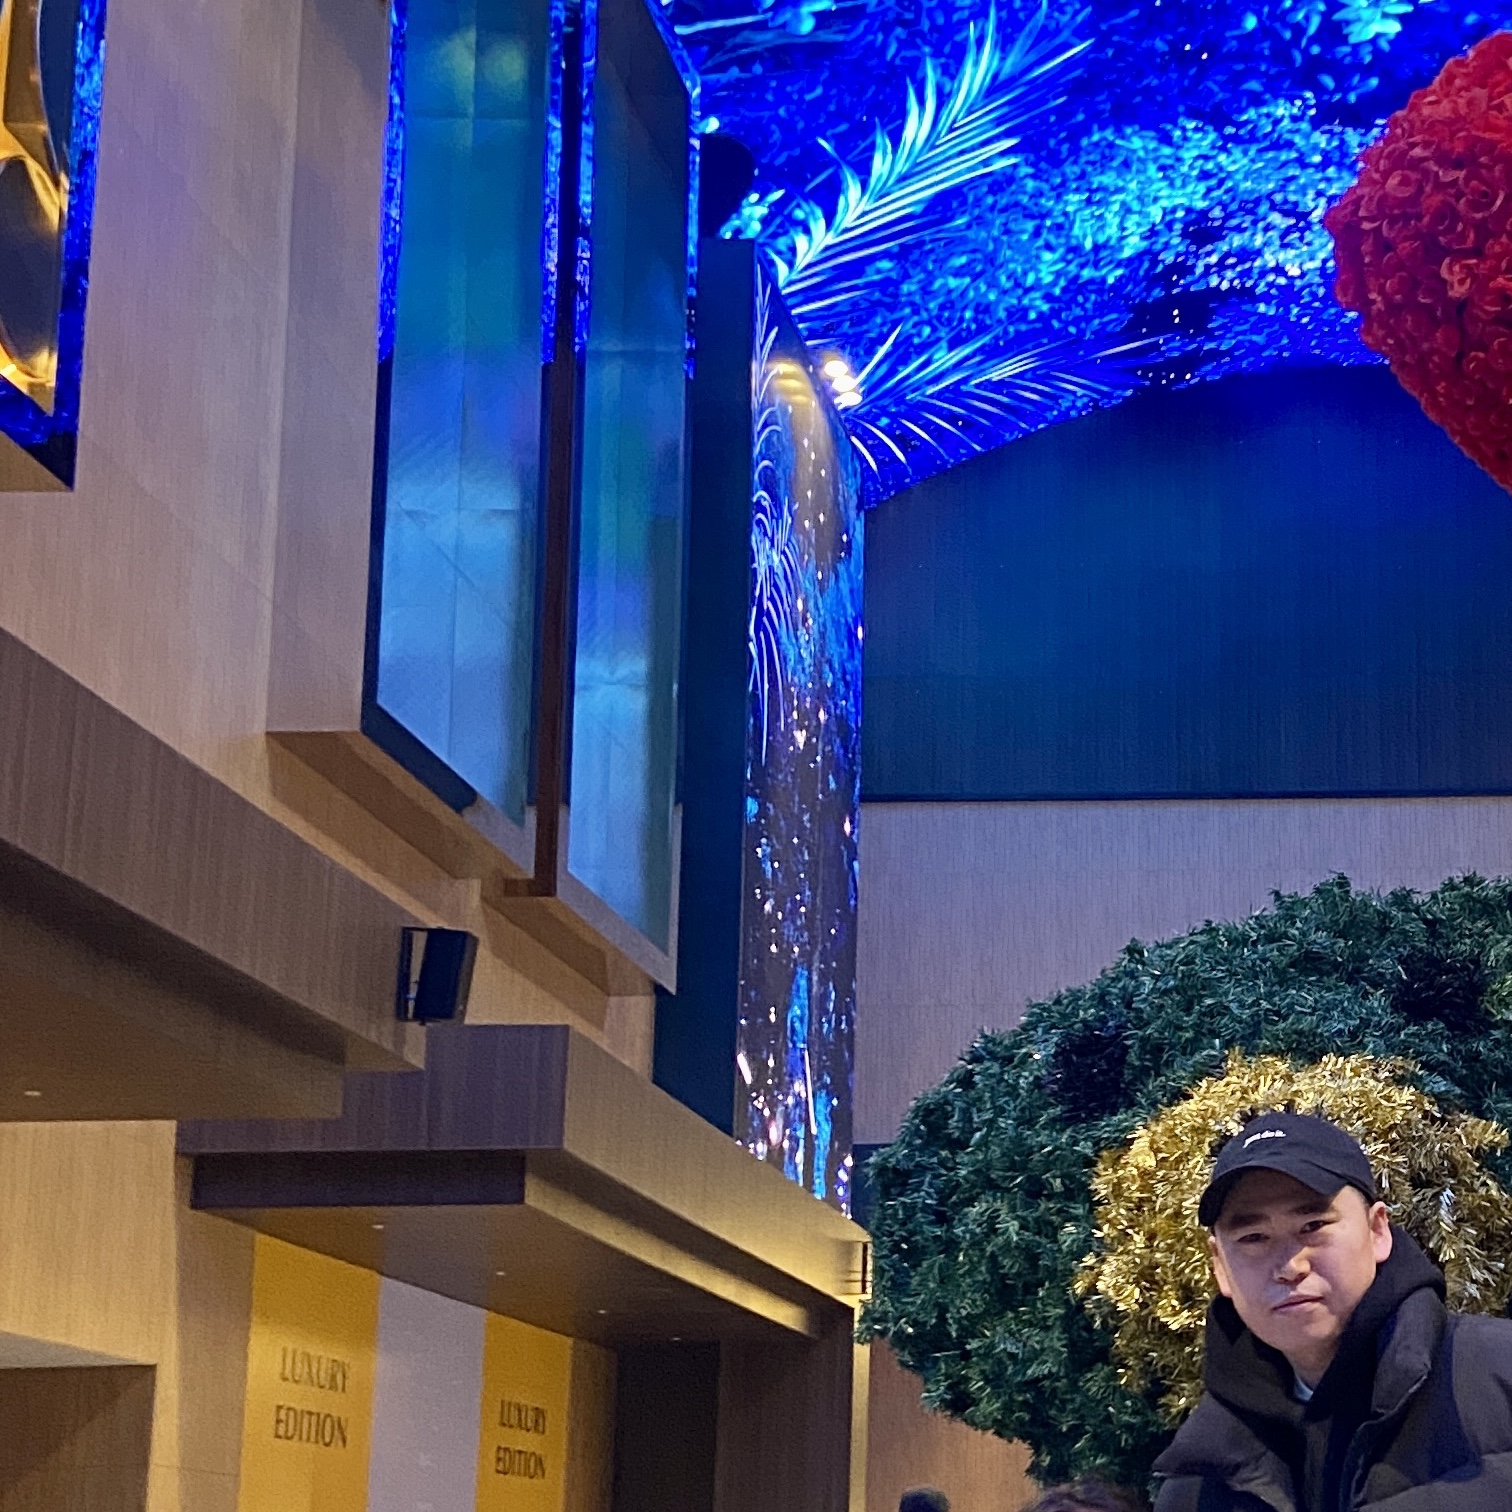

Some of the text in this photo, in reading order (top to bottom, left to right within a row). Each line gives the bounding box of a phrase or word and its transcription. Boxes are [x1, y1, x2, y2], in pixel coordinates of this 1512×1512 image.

[280, 1346, 350, 1394] LUXURY
[274, 1404, 348, 1449] EDITION
[499, 1400, 546, 1435] LUXURY
[495, 1445, 546, 1479] EDITION
